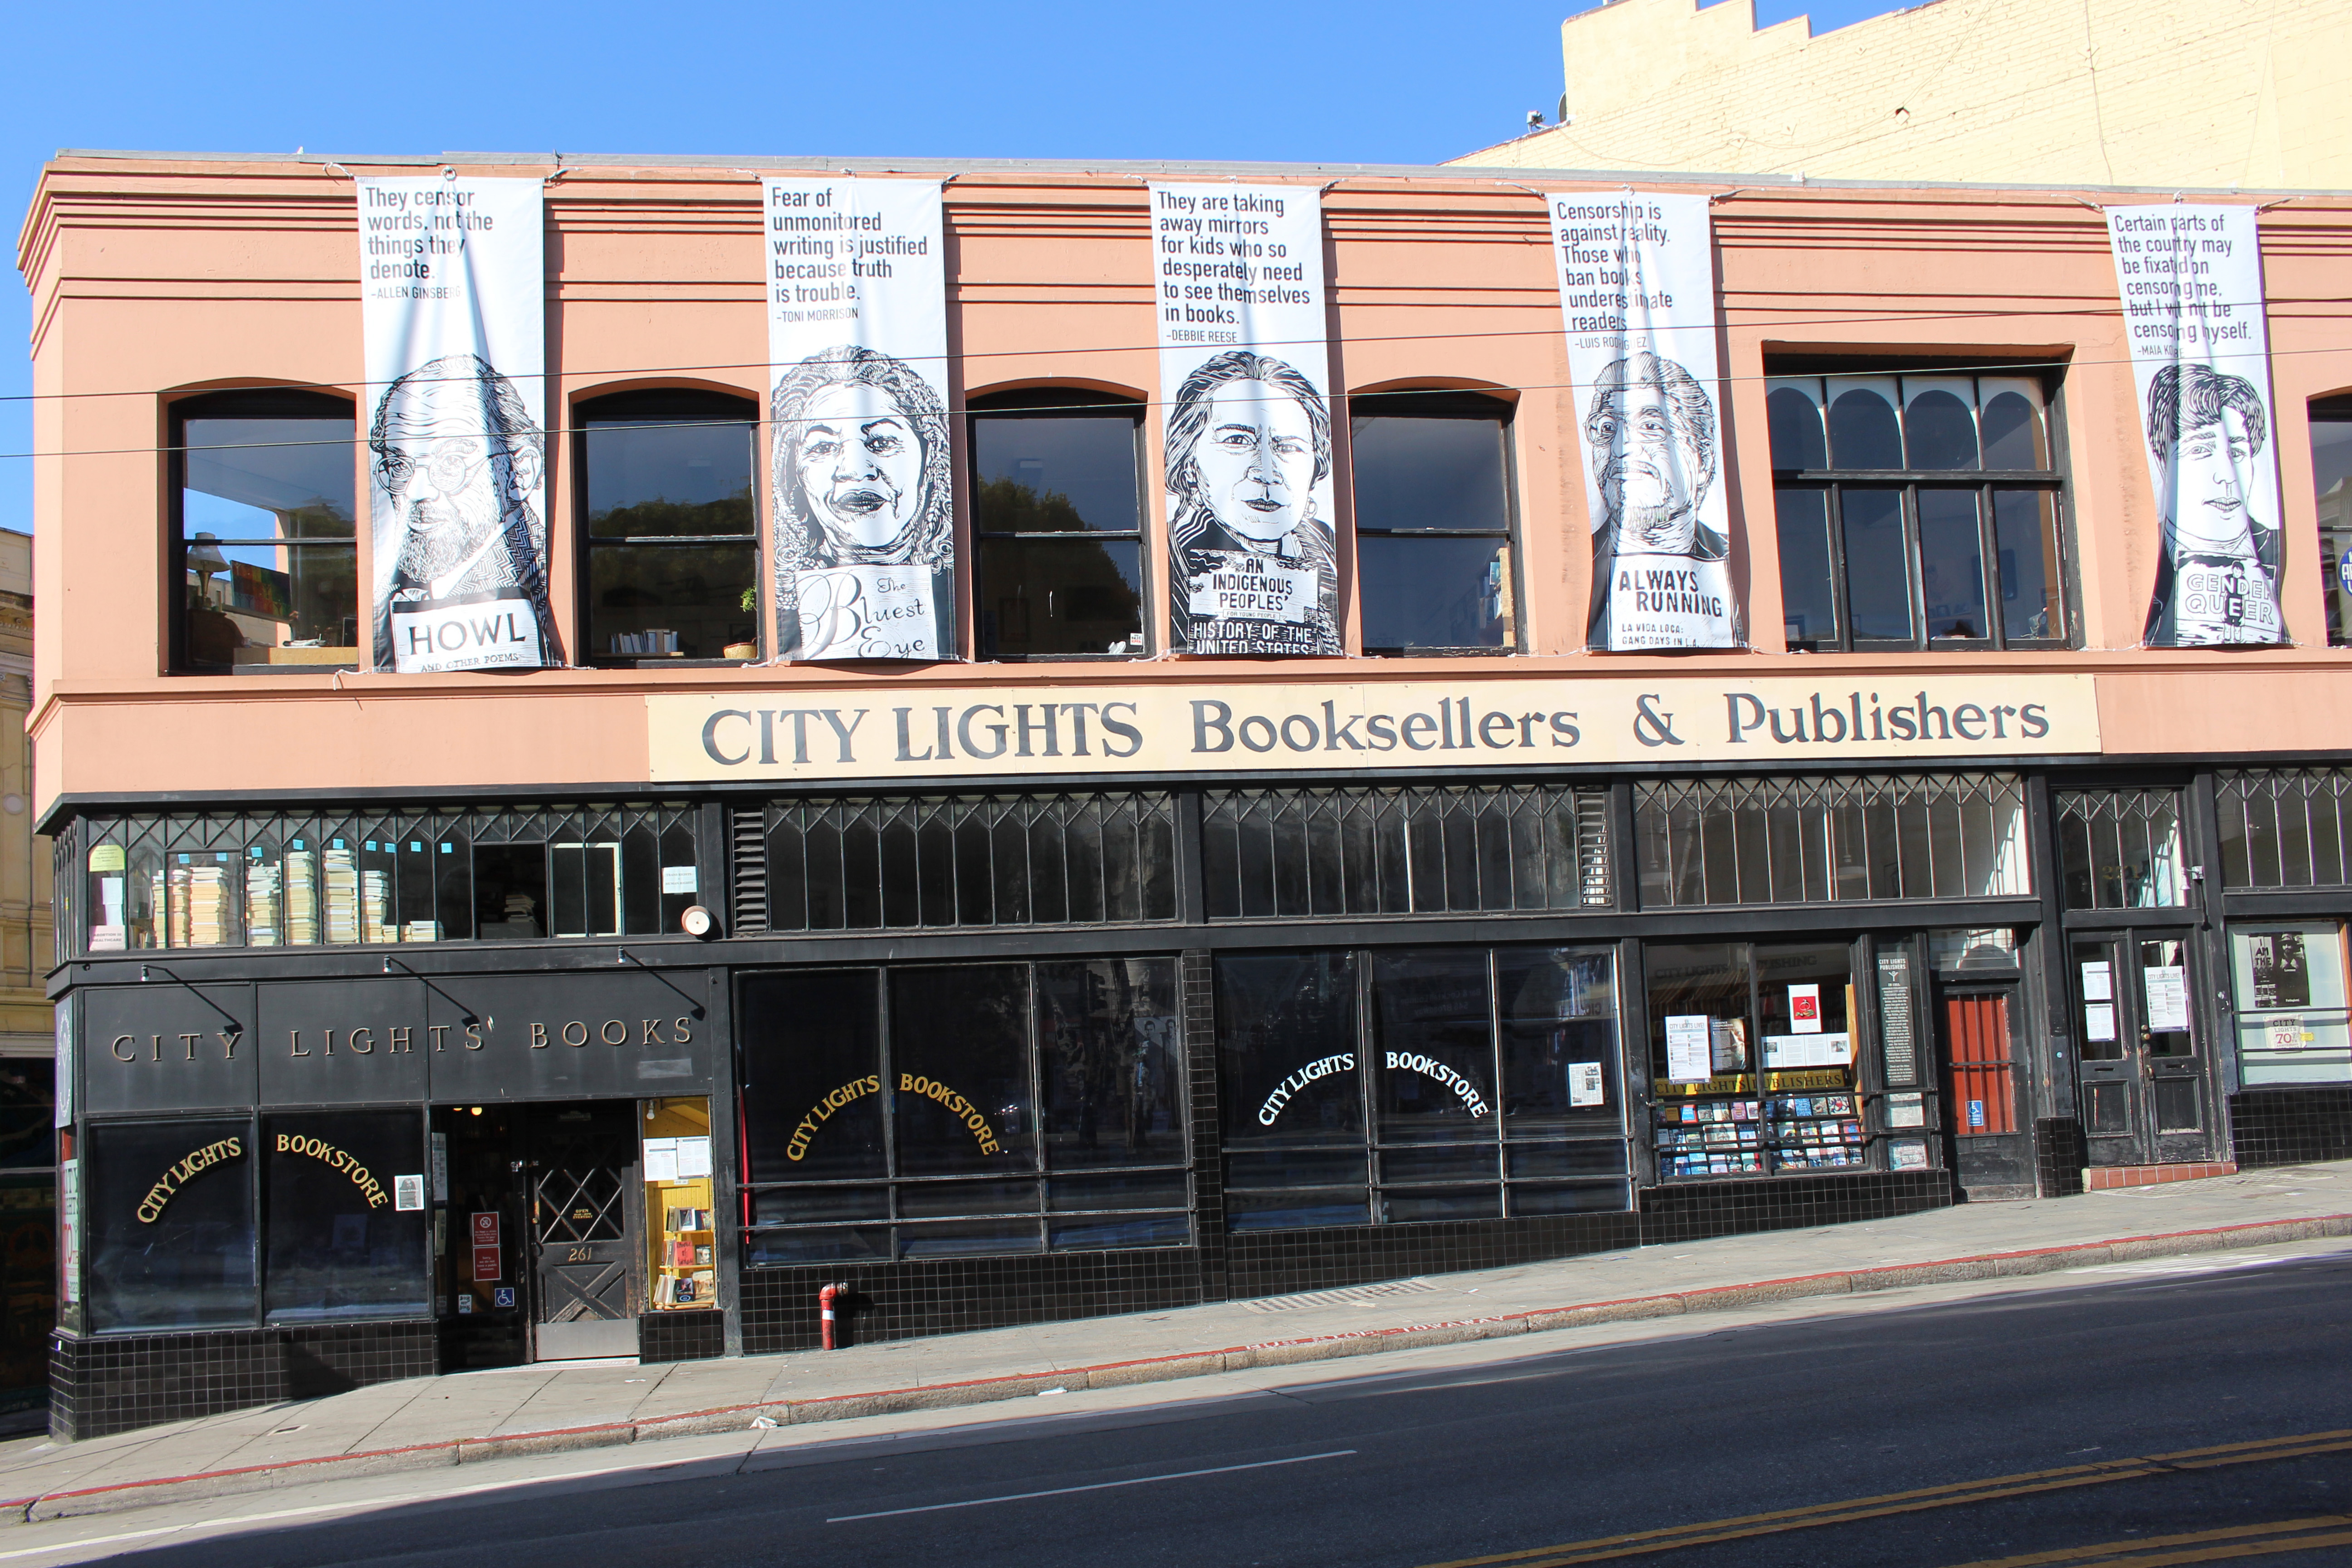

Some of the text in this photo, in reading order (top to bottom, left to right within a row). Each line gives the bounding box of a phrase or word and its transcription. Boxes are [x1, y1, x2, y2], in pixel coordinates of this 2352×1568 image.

[366, 187, 475, 211] They censor
[772, 186, 832, 207] Fear of
[1157, 191, 1284, 218] They are taking
[368, 211, 493, 231] words, not the
[773, 211, 882, 231] unmonitored
[1557, 201, 1662, 224] Censorship is
[1160, 215, 1269, 236] away mirrors
[1560, 223, 1671, 247] against reality.
[2115, 214, 2225, 235] Certain parts of
[368, 235, 465, 258] things they
[774, 235, 928, 260] writing is justified
[1161, 235, 1287, 258] for kids who so
[1562, 245, 1641, 264] Those who
[2117, 236, 2141, 253] the
[2202, 239, 2232, 257] may
[371, 260, 436, 279] denote.
[774, 258, 892, 279] because truth
[1163, 258, 1303, 286] desperately need
[2122, 257, 2141, 274] be
[2192, 261, 2209, 274] on
[1566, 267, 1642, 286] ban books
[412, 286, 461, 299] GINSBERG
[775, 281, 861, 303] is trouble.
[1163, 281, 1311, 304] to see themselves
[1569, 289, 1673, 310] underestimate
[2196, 282, 2222, 297] me,
[807, 307, 858, 322] MORRISON
[1165, 303, 1240, 324] in books.
[2129, 299, 2151, 317] but
[2156, 298, 2161, 316] I
[2213, 300, 2231, 318] be
[1208, 331, 1238, 343] REESE
[1245, 558, 1264, 573] AN
[877, 577, 907, 593] The
[1212, 574, 1293, 595] INDIGENOUS
[1619, 570, 1700, 593] ALWAYS
[1636, 591, 1723, 617] RUNNING
[2185, 594, 2274, 626] QUEER
[408, 612, 527, 656] HOWL
[1193, 621, 1313, 643] HISTORY OF THE
[1622, 623, 1684, 634] LA VIDA LOCA:
[858, 626, 926, 658] Eye
[1196, 639, 1309, 655] UNITED STATES
[1622, 636, 1646, 645] GANG
[1649, 636, 1670, 646] DAYS
[1673, 636, 1682, 646] IN
[421, 652, 519, 672] AND OTHER POEMS
[701, 690, 2048, 765] CITY LIGHTS Booksellers & Publishers
[2254, 957, 2272, 966] THE
[2256, 947, 2269, 956] AM
[112, 1016, 693, 1063] CITY LIGHTS BOOKS
[2275, 1033, 2292, 1044] 70
[1258, 1051, 1489, 1126] CITY LIGHTS BOOKSTORE
[786, 1073, 1000, 1161] CITY LIGHTS BOOKSTORE
[137, 1171, 176, 1224] CITY
[169, 1137, 242, 1185] LIGHTS
[276, 1133, 389, 1209] BOOKSTORE
[568, 1247, 592, 1262] 261
